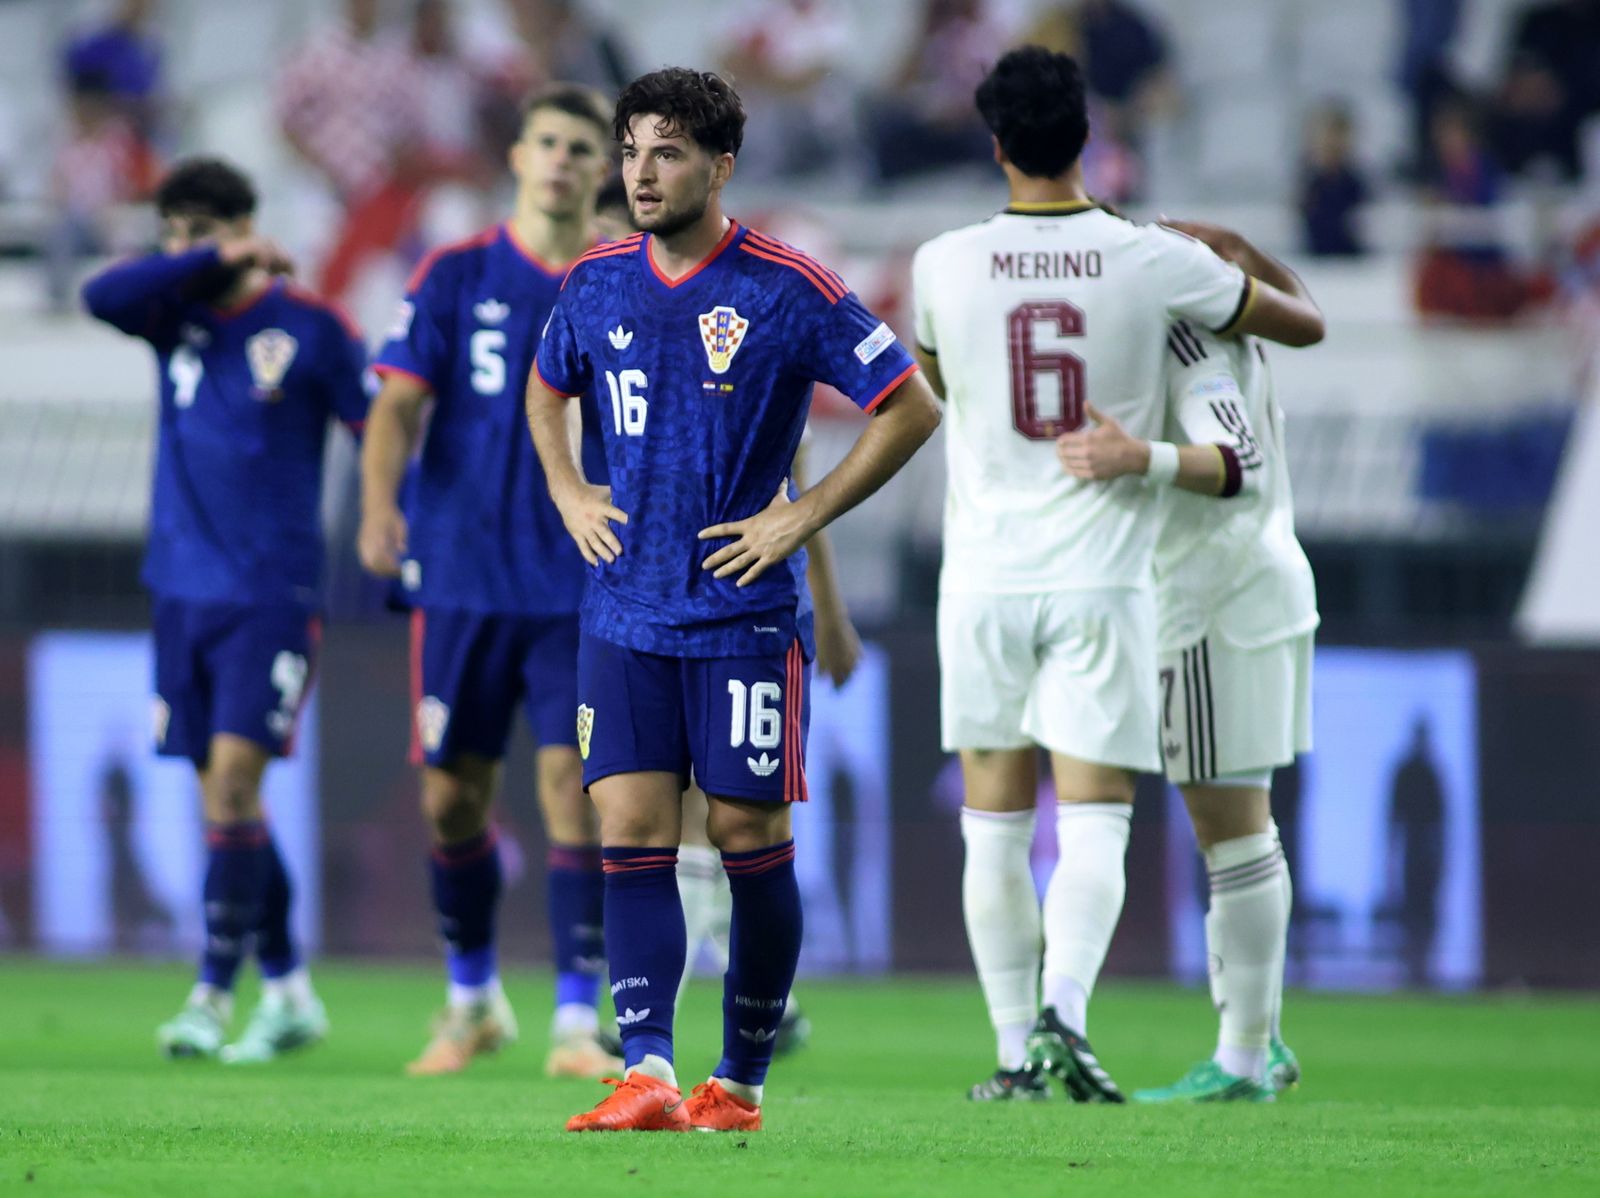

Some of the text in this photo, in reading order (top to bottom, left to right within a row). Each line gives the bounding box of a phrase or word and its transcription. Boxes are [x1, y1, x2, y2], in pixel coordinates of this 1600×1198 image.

[990, 249, 1102, 279] MERINO
[470, 329, 507, 395] 5
[1006, 298, 1087, 441] 6
[605, 369, 649, 437] 16
[728, 679, 782, 748] 16
